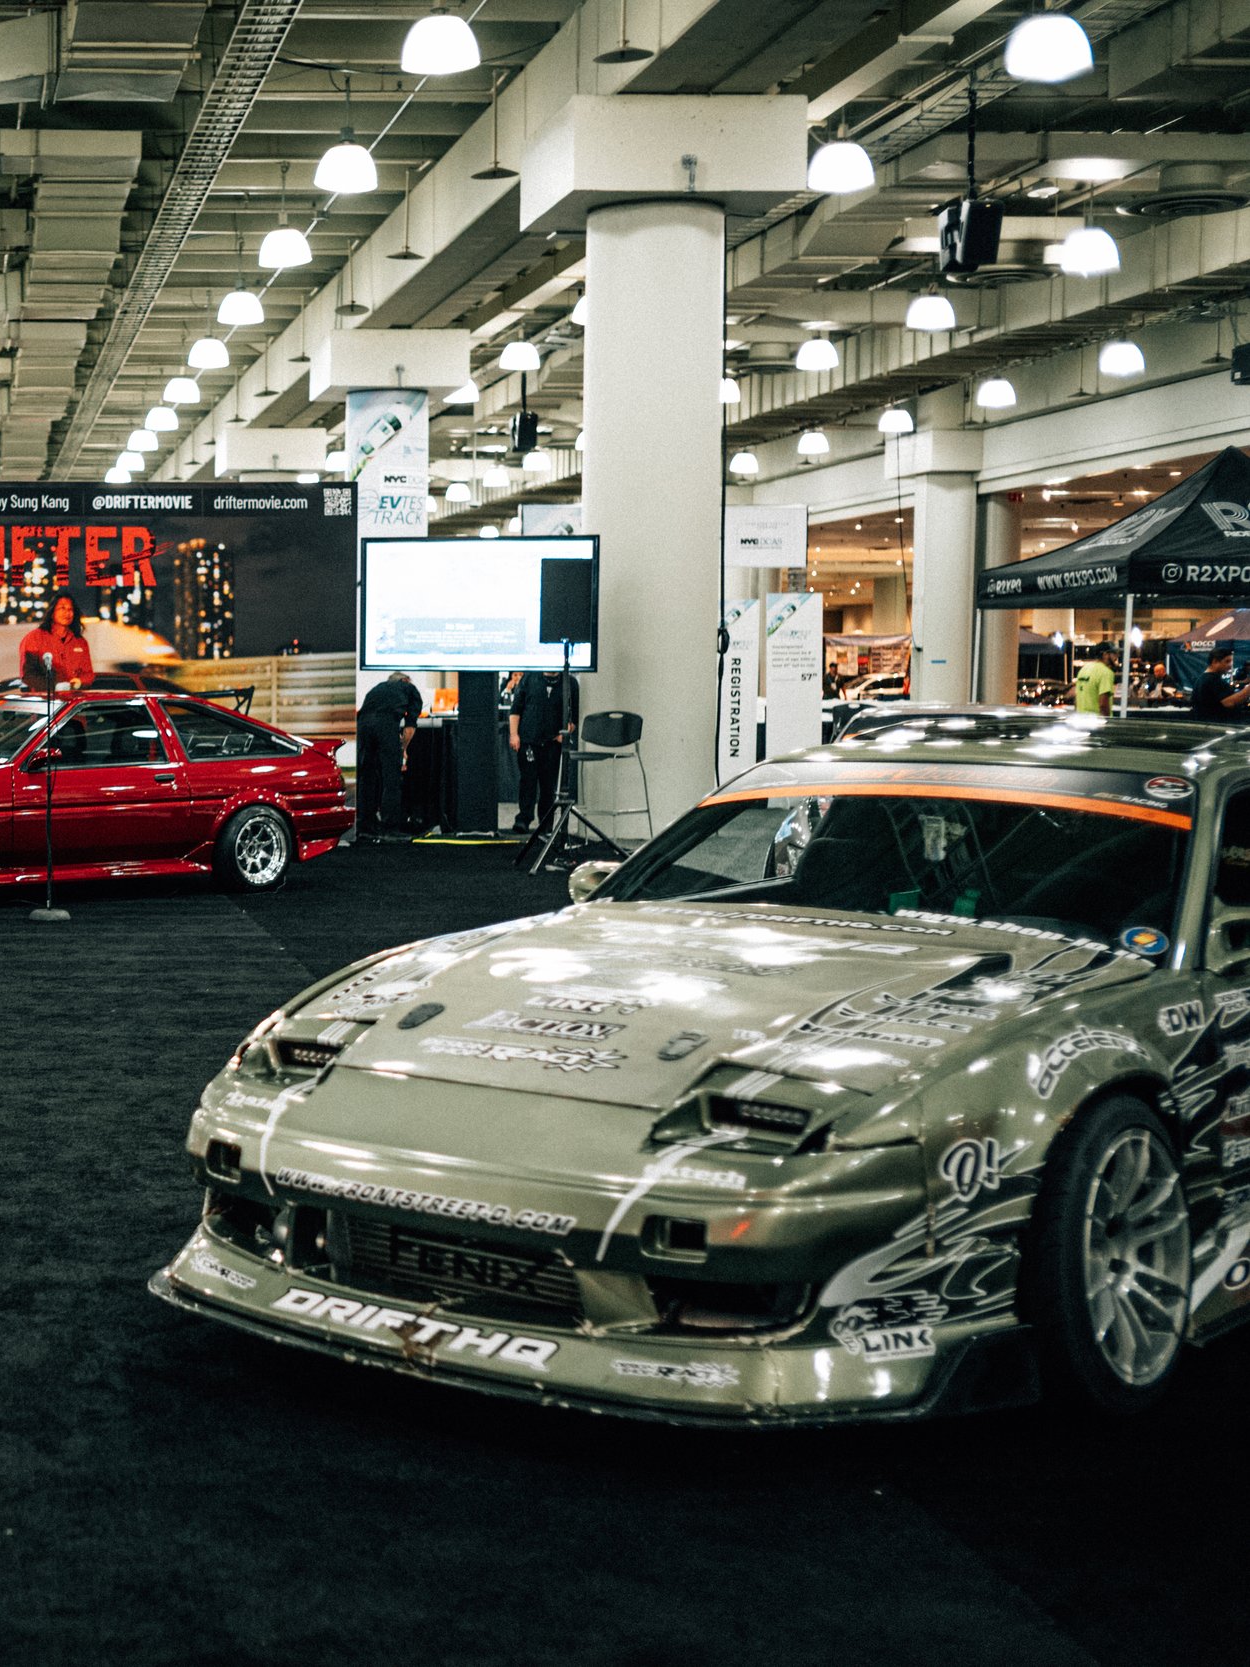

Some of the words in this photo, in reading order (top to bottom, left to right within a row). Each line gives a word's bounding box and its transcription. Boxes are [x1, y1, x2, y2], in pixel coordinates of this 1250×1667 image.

[383, 475, 407, 483] NYC
[10, 494, 39, 512] Sung
[41, 494, 70, 512] Kang
[92, 494, 193, 510] @DRIFTERMOVIE
[213, 494, 308, 510] driftermovie.com
[379, 495, 424, 510] EVTES
[370, 510, 423, 525] TRACK
[1036, 566, 1118, 591] WWW.R2XPO.COM
[729, 657, 742, 758] REGISTRATION
[1121, 795, 1169, 809] RACING
[1163, 1000, 1205, 1036] DW
[275, 1167, 578, 1236] WWW.FRONTSTREET-D.COM
[388, 1226, 540, 1296] FENIX
[270, 1286, 561, 1370] DRIFTHQ
[861, 1328, 933, 1354] LINK
